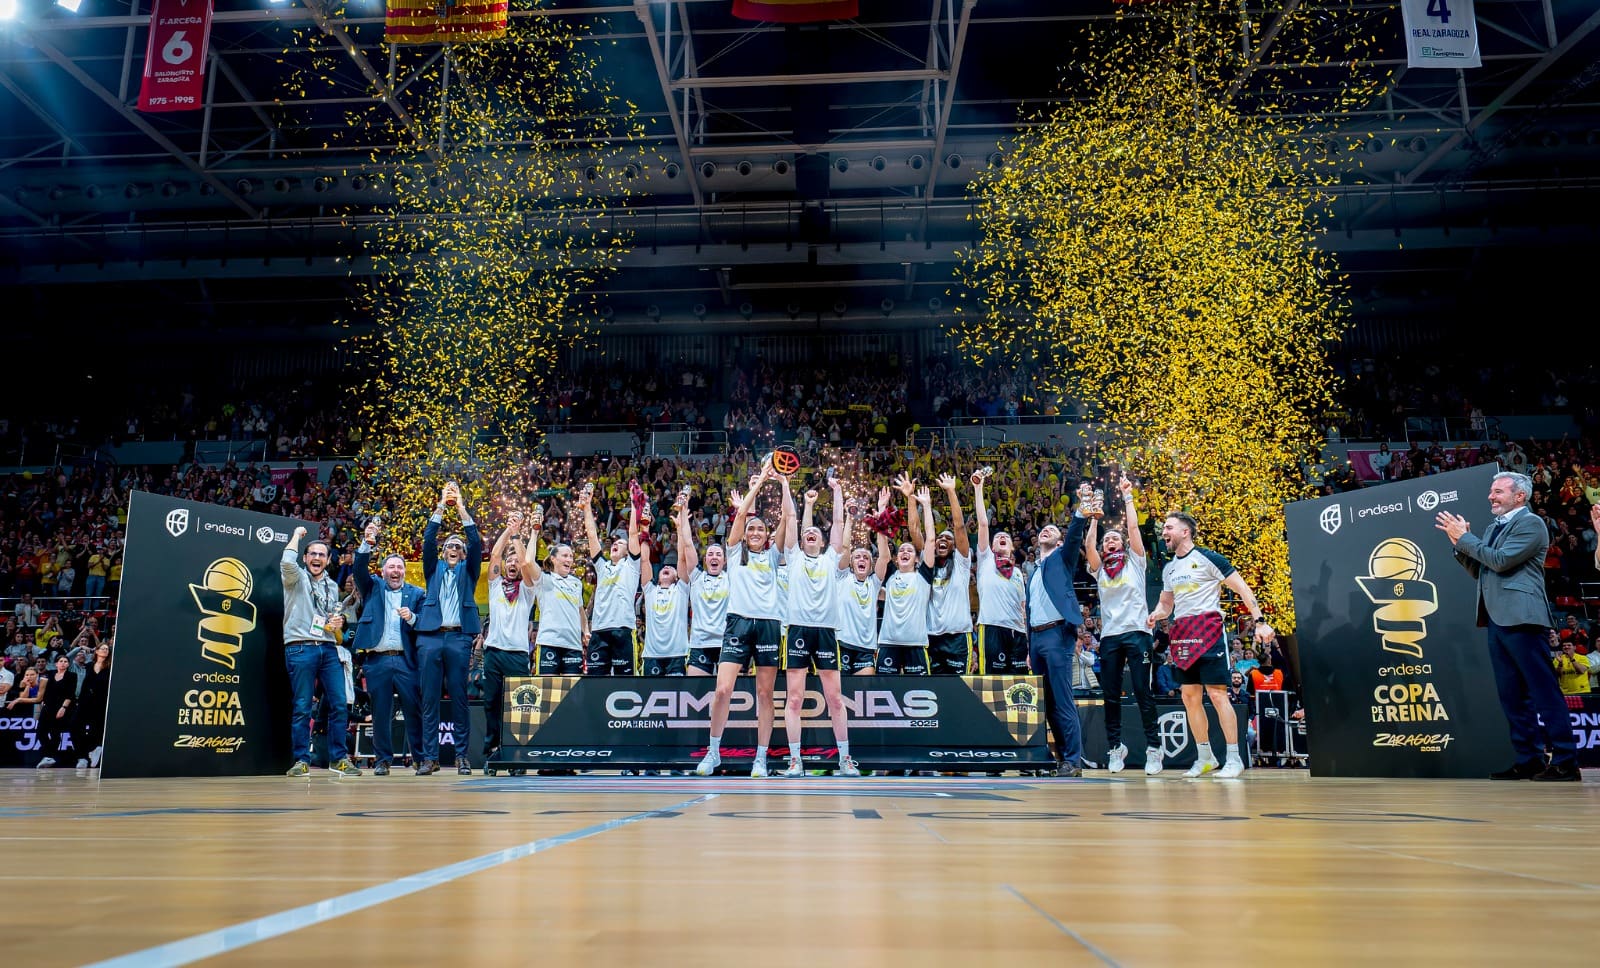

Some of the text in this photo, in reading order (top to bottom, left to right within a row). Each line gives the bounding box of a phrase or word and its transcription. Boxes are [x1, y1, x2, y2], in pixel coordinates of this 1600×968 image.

[1426, 0, 1451, 23] 4
[1412, 29, 1469, 38] REAL ZARAGOZA
[162, 31, 193, 65] 6
[149, 97, 167, 105] 1975
[1358, 503, 1403, 518] endesa
[204, 522, 245, 536] endesa
[1378, 663, 1432, 677] endesa
[192, 672, 240, 684] endesa
[184, 689, 242, 709] COPA
[1374, 683, 1441, 704] COPA
[178, 708, 246, 726] DE LA REINA
[1371, 703, 1449, 723] DE LA REINA
[607, 720, 632, 729] COPA
[638, 720, 665, 729] REINA
[173, 735, 247, 750] ZARAGOZA
[1373, 733, 1455, 749] ZARAGOZA
[527, 748, 613, 757] endesa
[928, 750, 1017, 758] endesa
